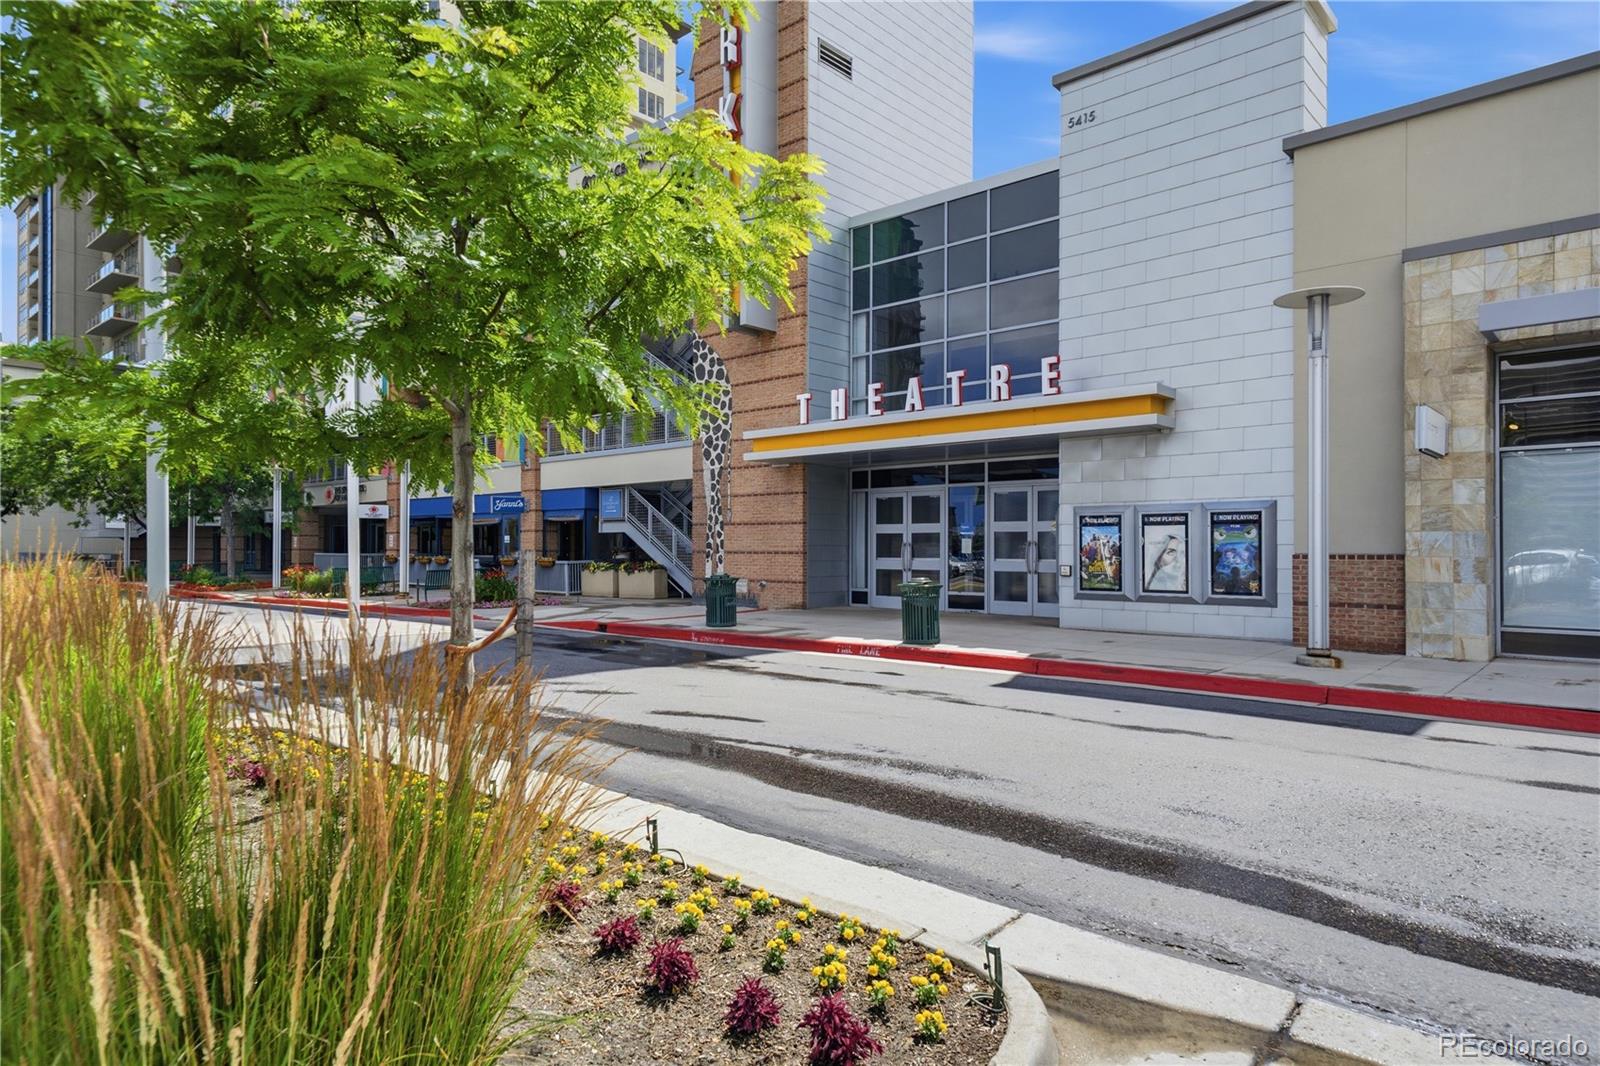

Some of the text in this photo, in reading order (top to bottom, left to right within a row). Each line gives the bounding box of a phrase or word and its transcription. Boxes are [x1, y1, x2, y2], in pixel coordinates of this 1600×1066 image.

[1067, 110, 1096, 129] 5415
[796, 355, 1061, 425] THEATRE
[859, 646, 881, 657] LANE
